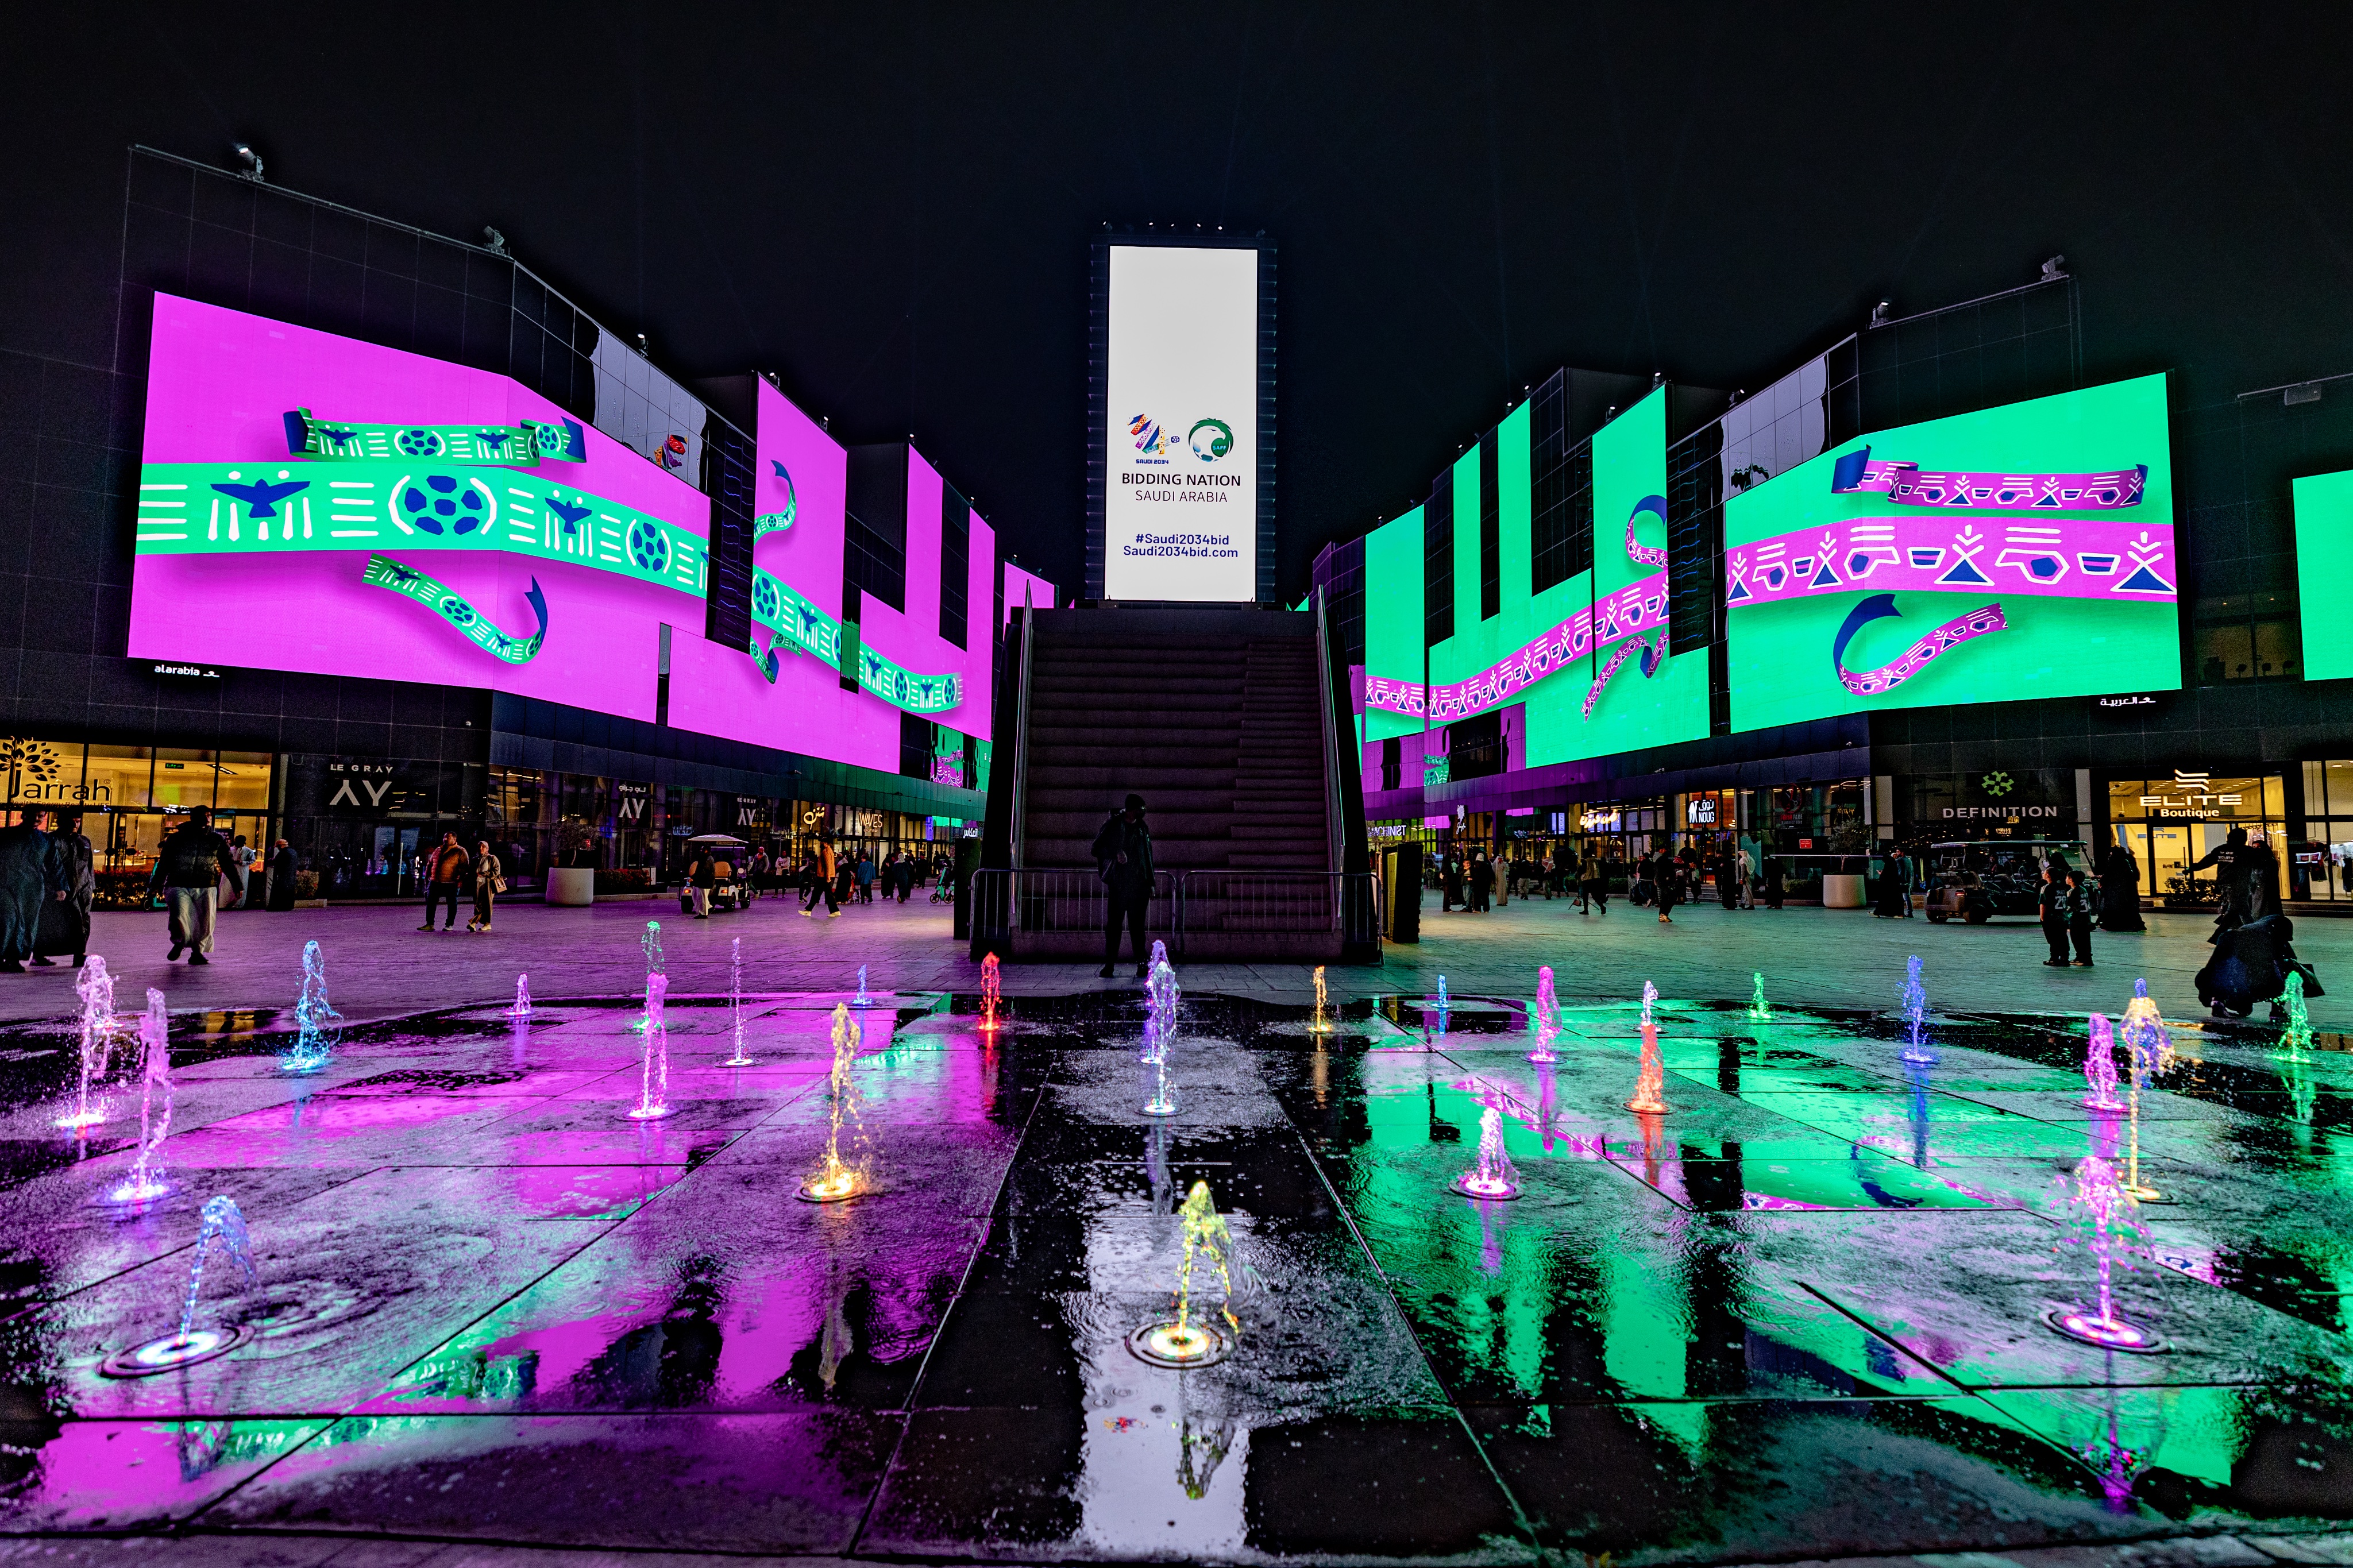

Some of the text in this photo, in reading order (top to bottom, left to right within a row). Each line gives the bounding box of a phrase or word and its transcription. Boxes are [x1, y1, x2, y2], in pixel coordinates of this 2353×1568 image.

[1122, 473, 1241, 486] BIDDING NATION
[1135, 490, 1228, 503] SAUDI ARABIA
[1136, 534, 1229, 545] #Saudi2034bid
[1123, 546, 1238, 557] Saudi2034bid.com
[154, 664, 200, 676] alarabia
[2100, 696, 2138, 707] العربية
[330, 763, 394, 773] LE GRAY
[1698, 799, 1714, 812] نوق
[2139, 794, 2243, 806] ELITE
[1698, 812, 1715, 823] NOUG
[1943, 806, 2057, 818] DEFINITION
[2161, 808, 2220, 819] Boutique
[859, 812, 882, 828] WAVES
[2055, 895, 2066, 910] 20
